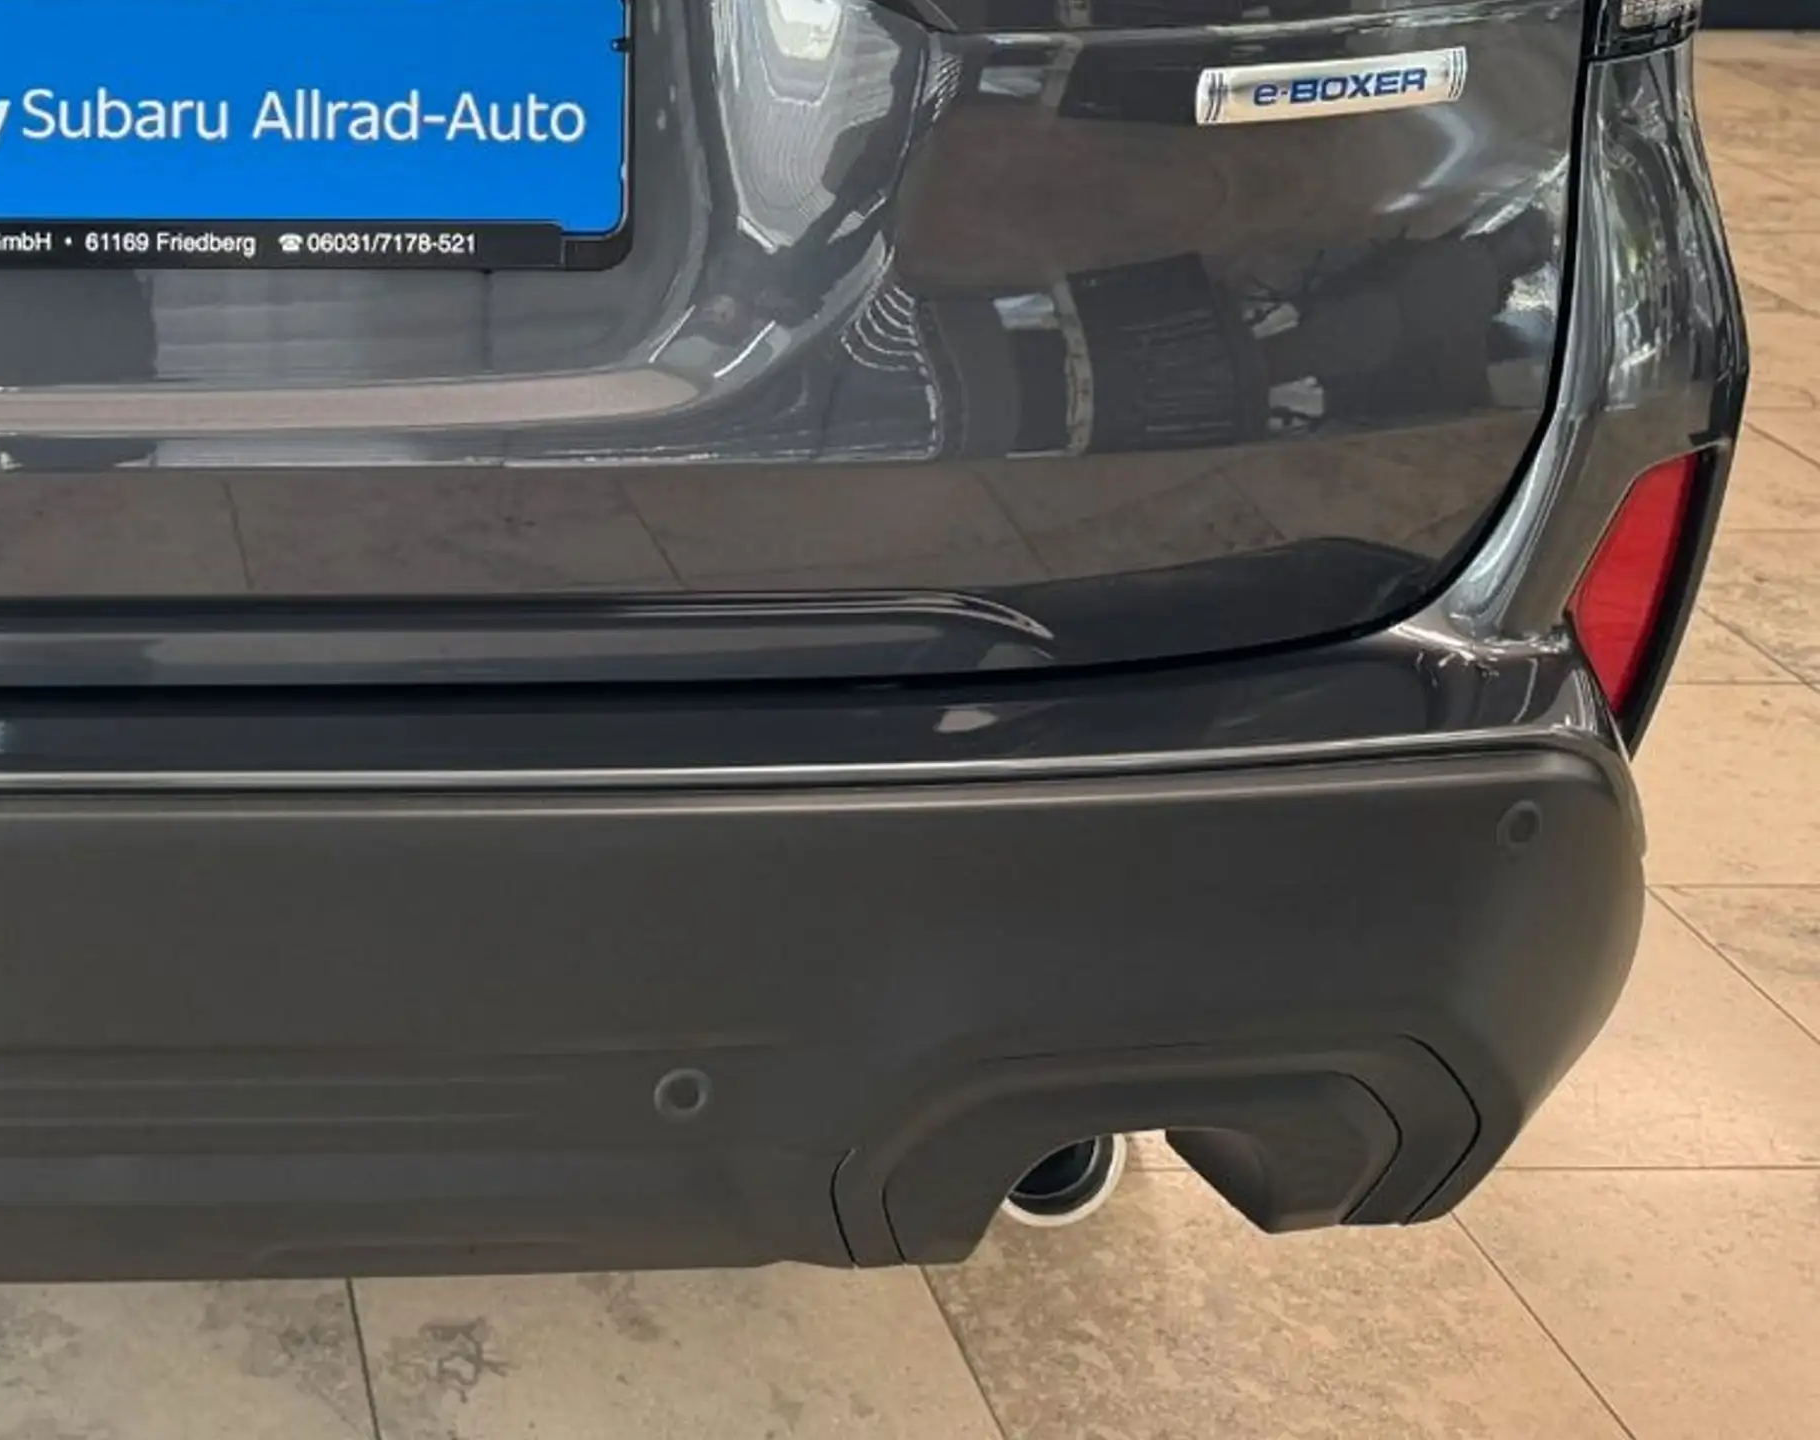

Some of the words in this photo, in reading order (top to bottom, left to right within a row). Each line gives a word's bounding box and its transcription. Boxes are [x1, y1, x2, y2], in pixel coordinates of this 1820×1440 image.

[1253, 67, 1428, 107] e-BOXER
[23, 87, 228, 140] Subaru
[252, 88, 585, 142] Allrad-Auto
[84, 232, 150, 252] 61169
[156, 231, 257, 259] Friedberg
[306, 232, 477, 254] 06031/7178-521
